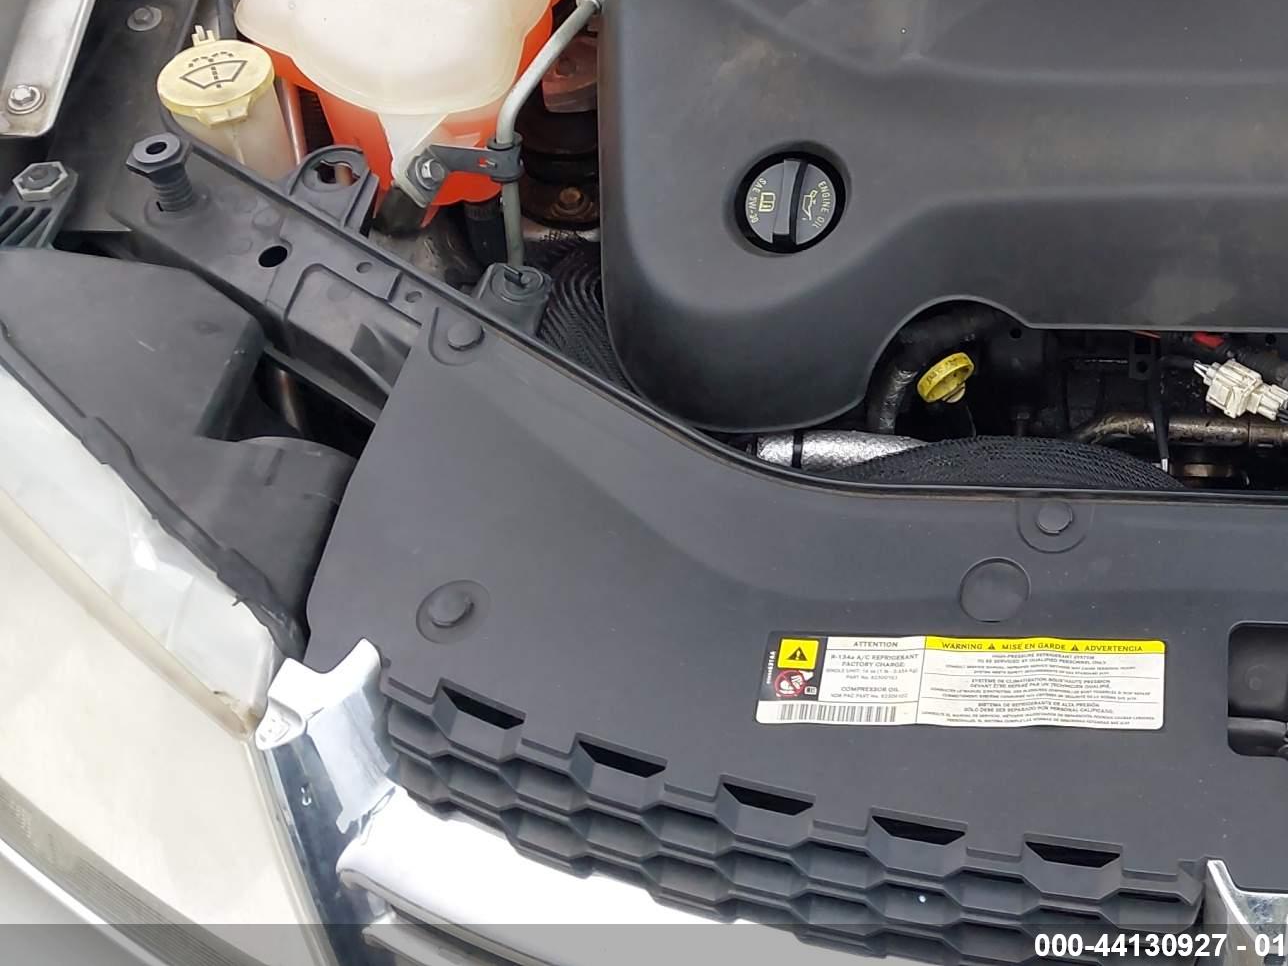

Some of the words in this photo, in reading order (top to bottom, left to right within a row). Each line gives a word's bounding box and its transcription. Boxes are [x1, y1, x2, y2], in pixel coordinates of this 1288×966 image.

[752, 177, 767, 194] SAE
[817, 180, 831, 214] ENGINE
[811, 216, 825, 229] OIL
[942, 642, 983, 650] WARNING
[1038, 642, 1066, 650] GARDE
